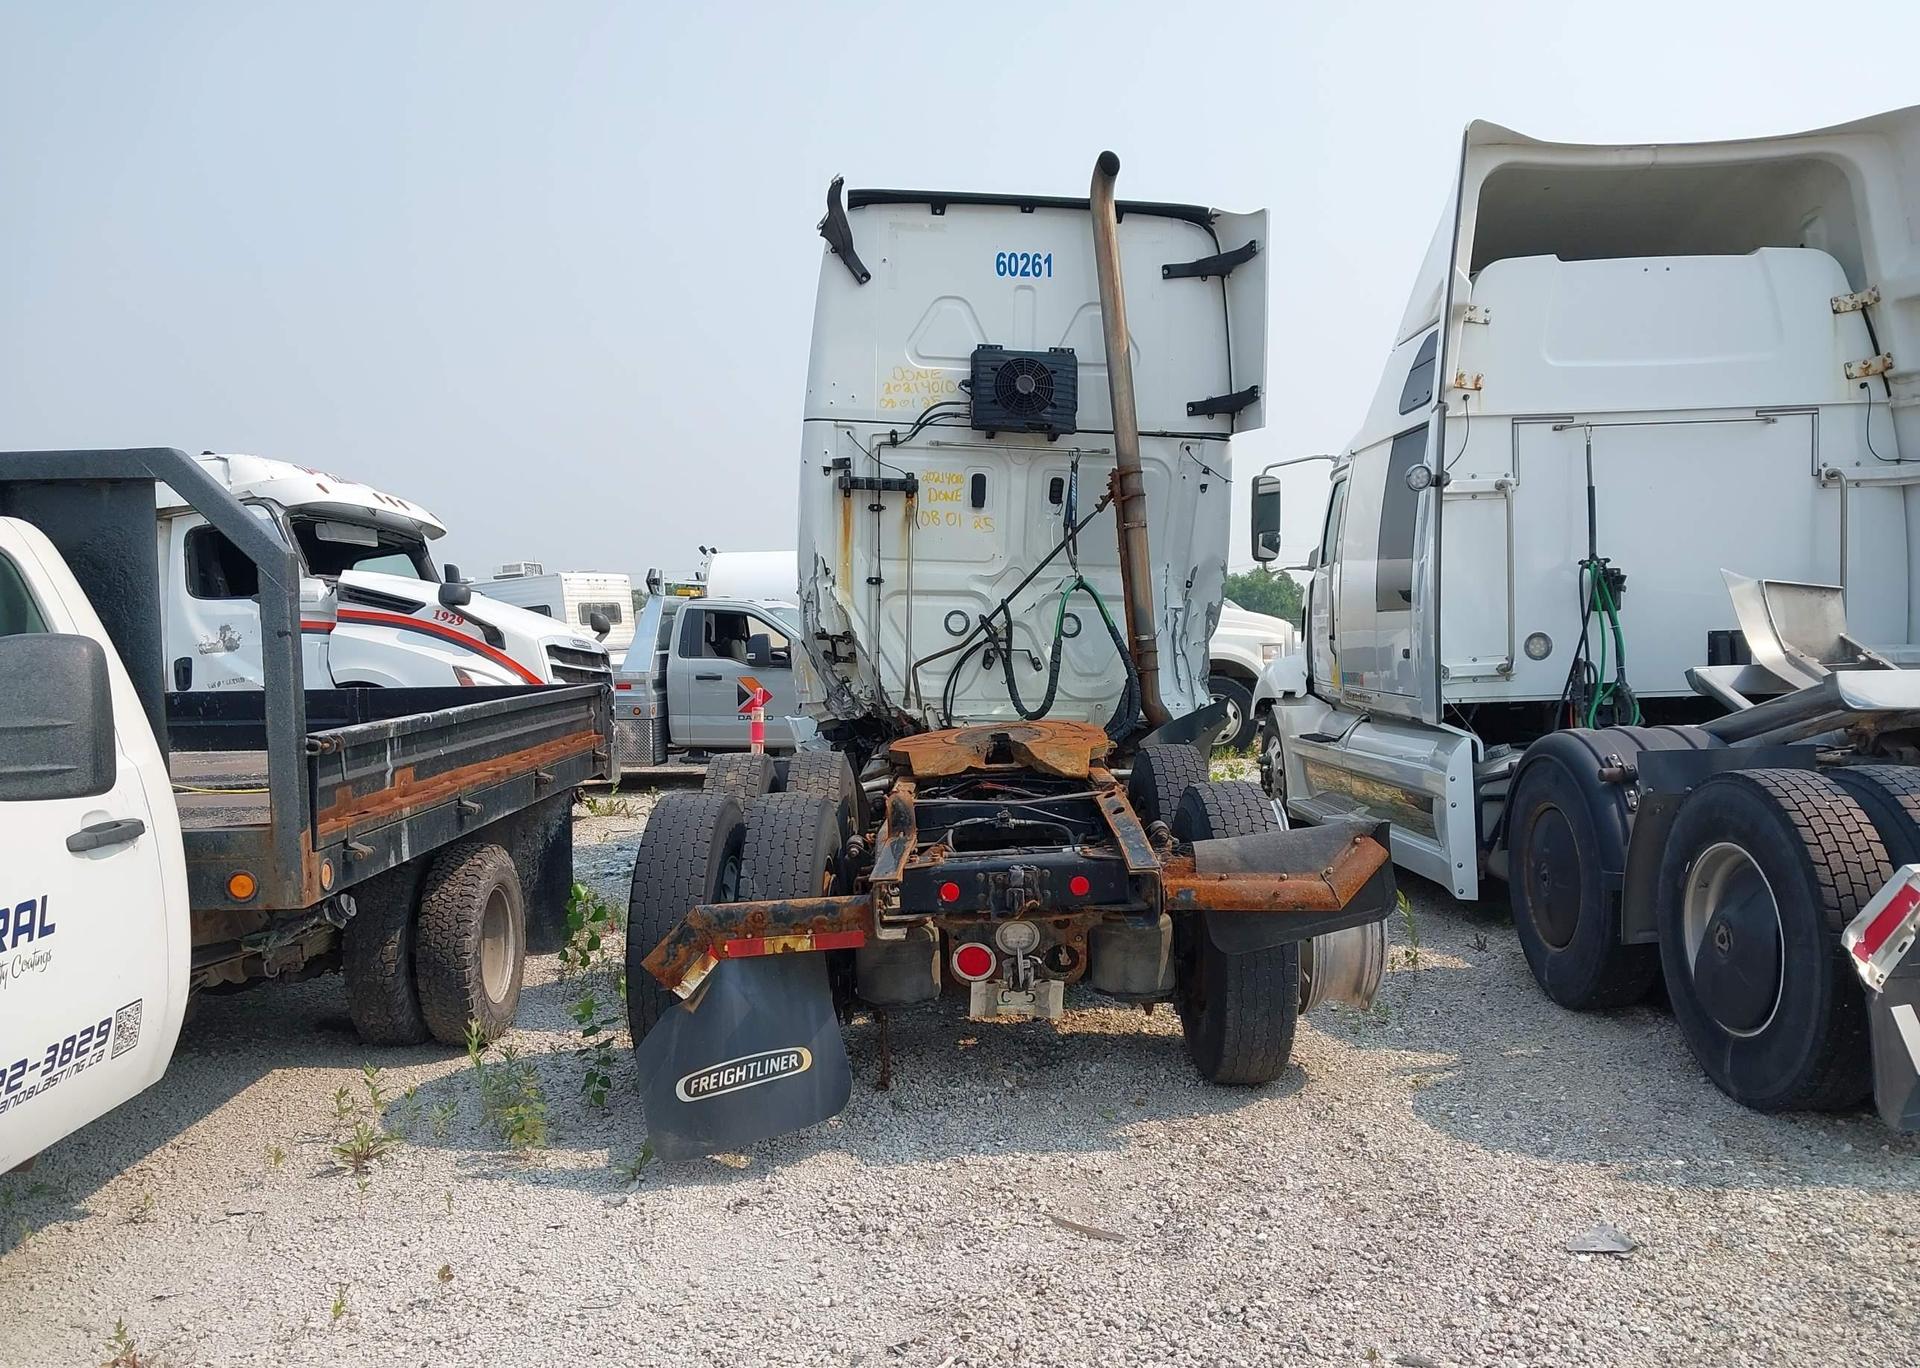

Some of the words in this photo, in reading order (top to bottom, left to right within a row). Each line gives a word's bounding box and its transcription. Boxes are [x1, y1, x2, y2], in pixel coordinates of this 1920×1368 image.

[995, 252, 1053, 278] 60261
[928, 487, 963, 503] DONE
[433, 609, 465, 626] 1929
[11, 948, 52, 979] Coatings
[689, 1052, 799, 1096] FREIGHTLINER
